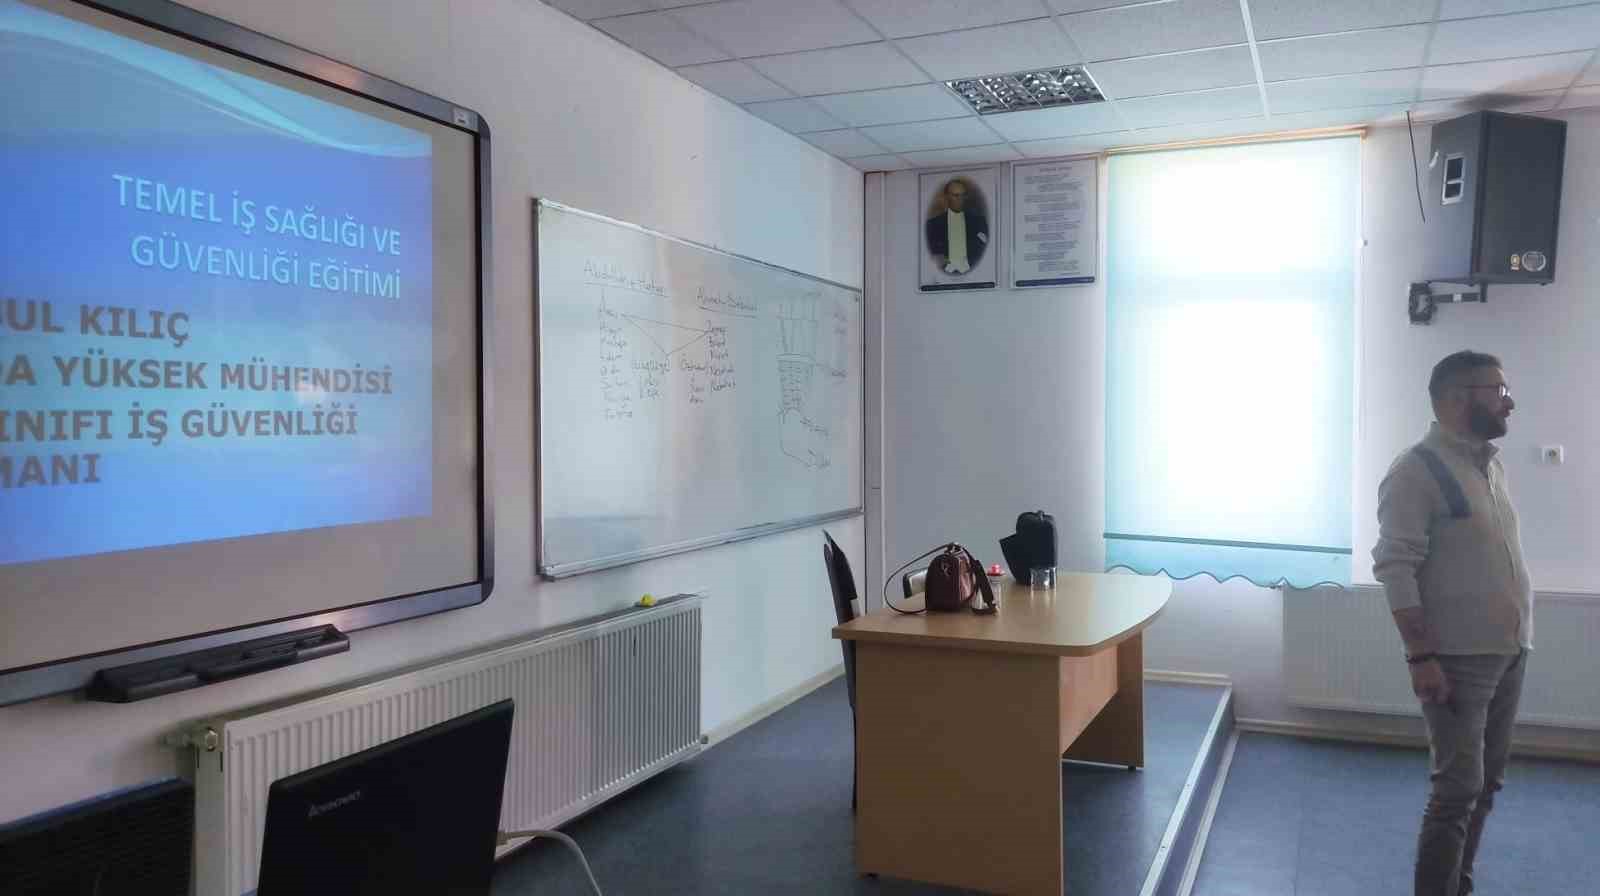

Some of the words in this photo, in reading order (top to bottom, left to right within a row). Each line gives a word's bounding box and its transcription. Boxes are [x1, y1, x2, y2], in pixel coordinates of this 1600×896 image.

[112, 174, 222, 222] TEMEL
[232, 190, 256, 235] İŞ
[265, 205, 364, 249] SAĞLIĞI
[373, 226, 400, 255] VE
[131, 231, 299, 284] GÜVENLİĞİ
[309, 257, 400, 299] EĞİTİMİ
[0, 299, 64, 333] UL
[80, 304, 190, 347] KILIÇ
[0, 353, 37, 386] A
[53, 348, 207, 390] YÜKSEK
[221, 357, 392, 394] MÜHENDİSİ
[128, 402, 168, 446] İŞ
[181, 402, 358, 437] GÜVENLİĞİ
